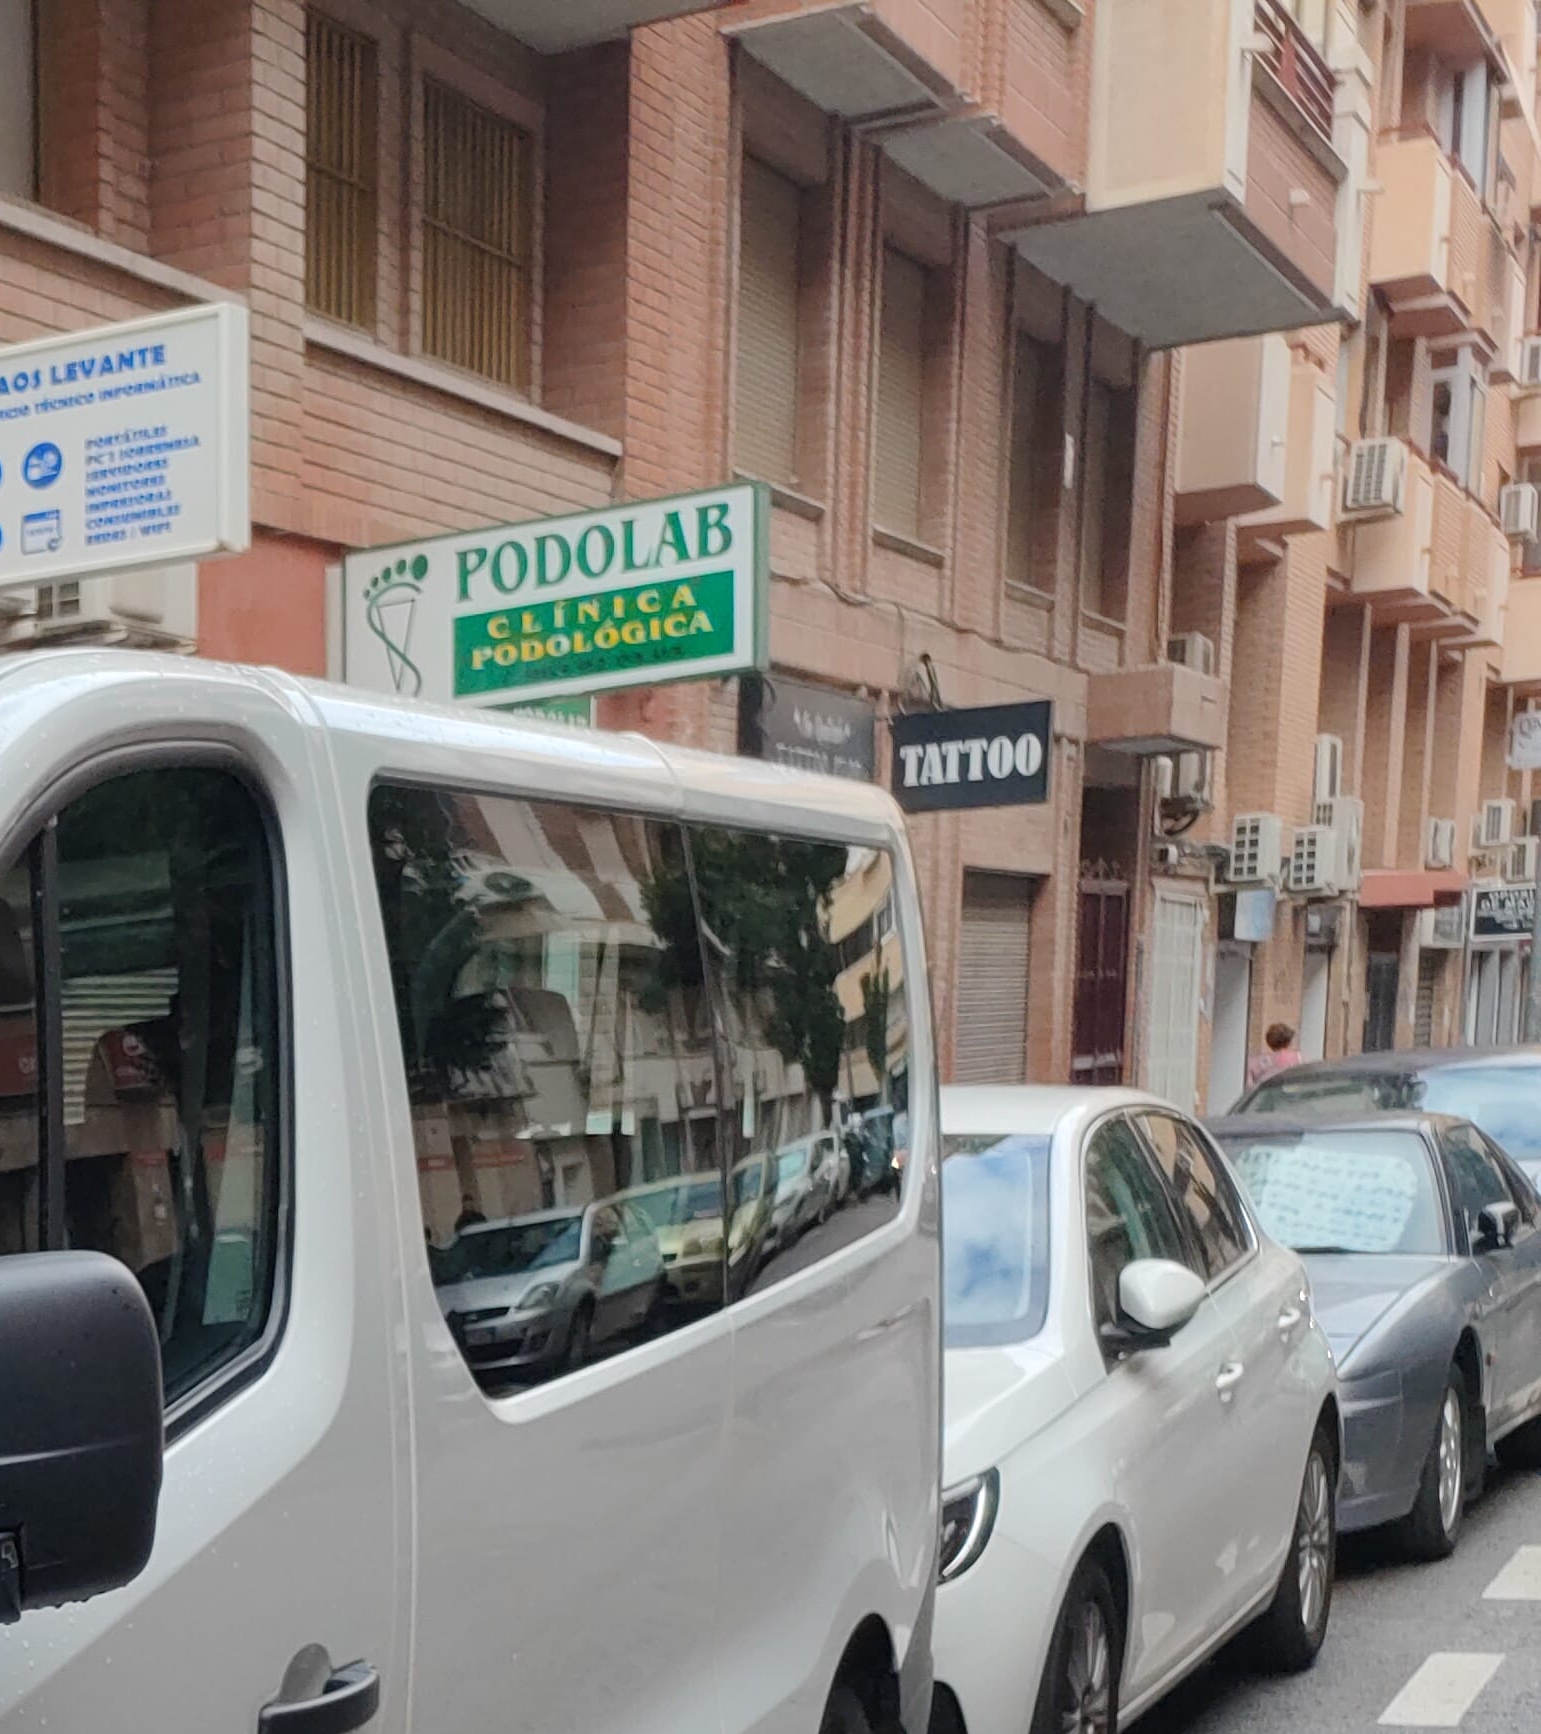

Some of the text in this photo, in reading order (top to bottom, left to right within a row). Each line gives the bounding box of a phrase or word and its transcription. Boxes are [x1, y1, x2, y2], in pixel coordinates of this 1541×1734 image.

[50, 344, 166, 386] LEVANTE
[454, 501, 733, 603] PODOLAB
[470, 609, 714, 671] PODOLÓGICA
[487, 584, 698, 640] CLÍNICA
[899, 732, 1043, 788] TATTOO
